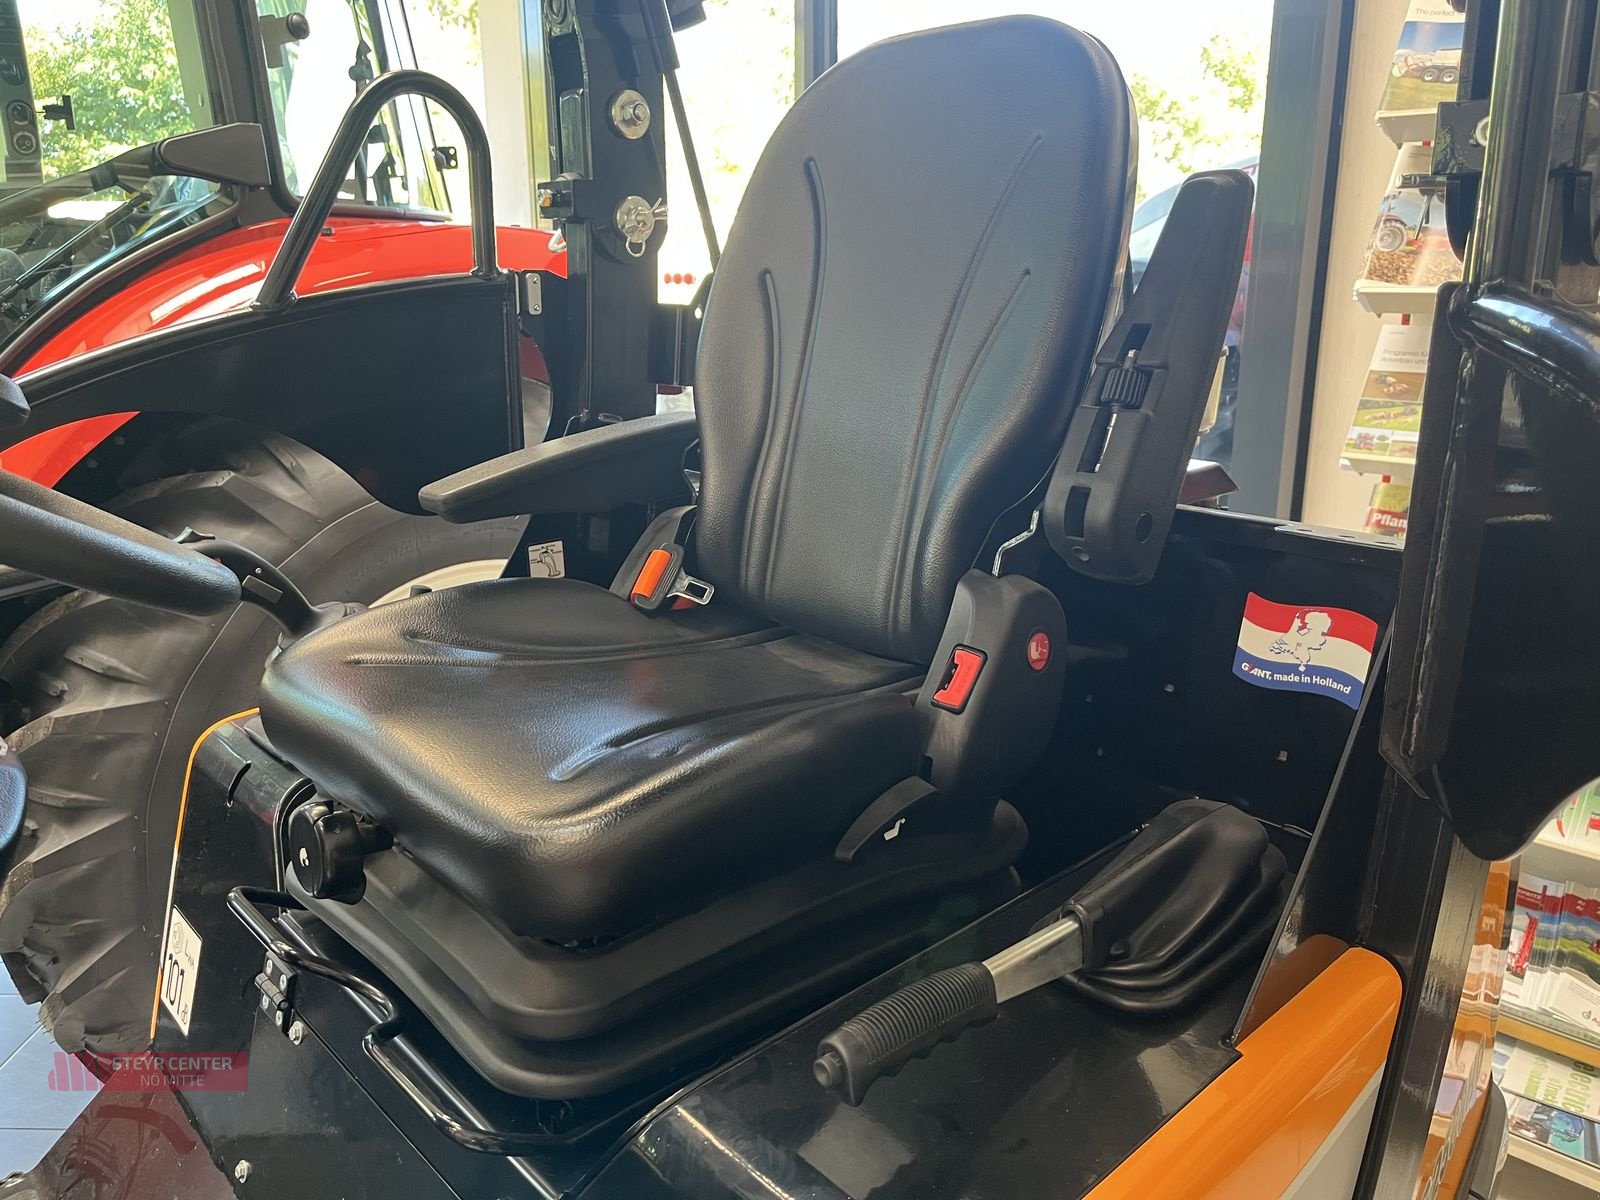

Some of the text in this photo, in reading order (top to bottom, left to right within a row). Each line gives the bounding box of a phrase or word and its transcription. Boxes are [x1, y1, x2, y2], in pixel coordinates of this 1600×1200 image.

[1273, 673, 1300, 682] made
[1301, 674, 1311, 683] in
[1312, 676, 1352, 694] Holland
[165, 953, 185, 1016] 101
